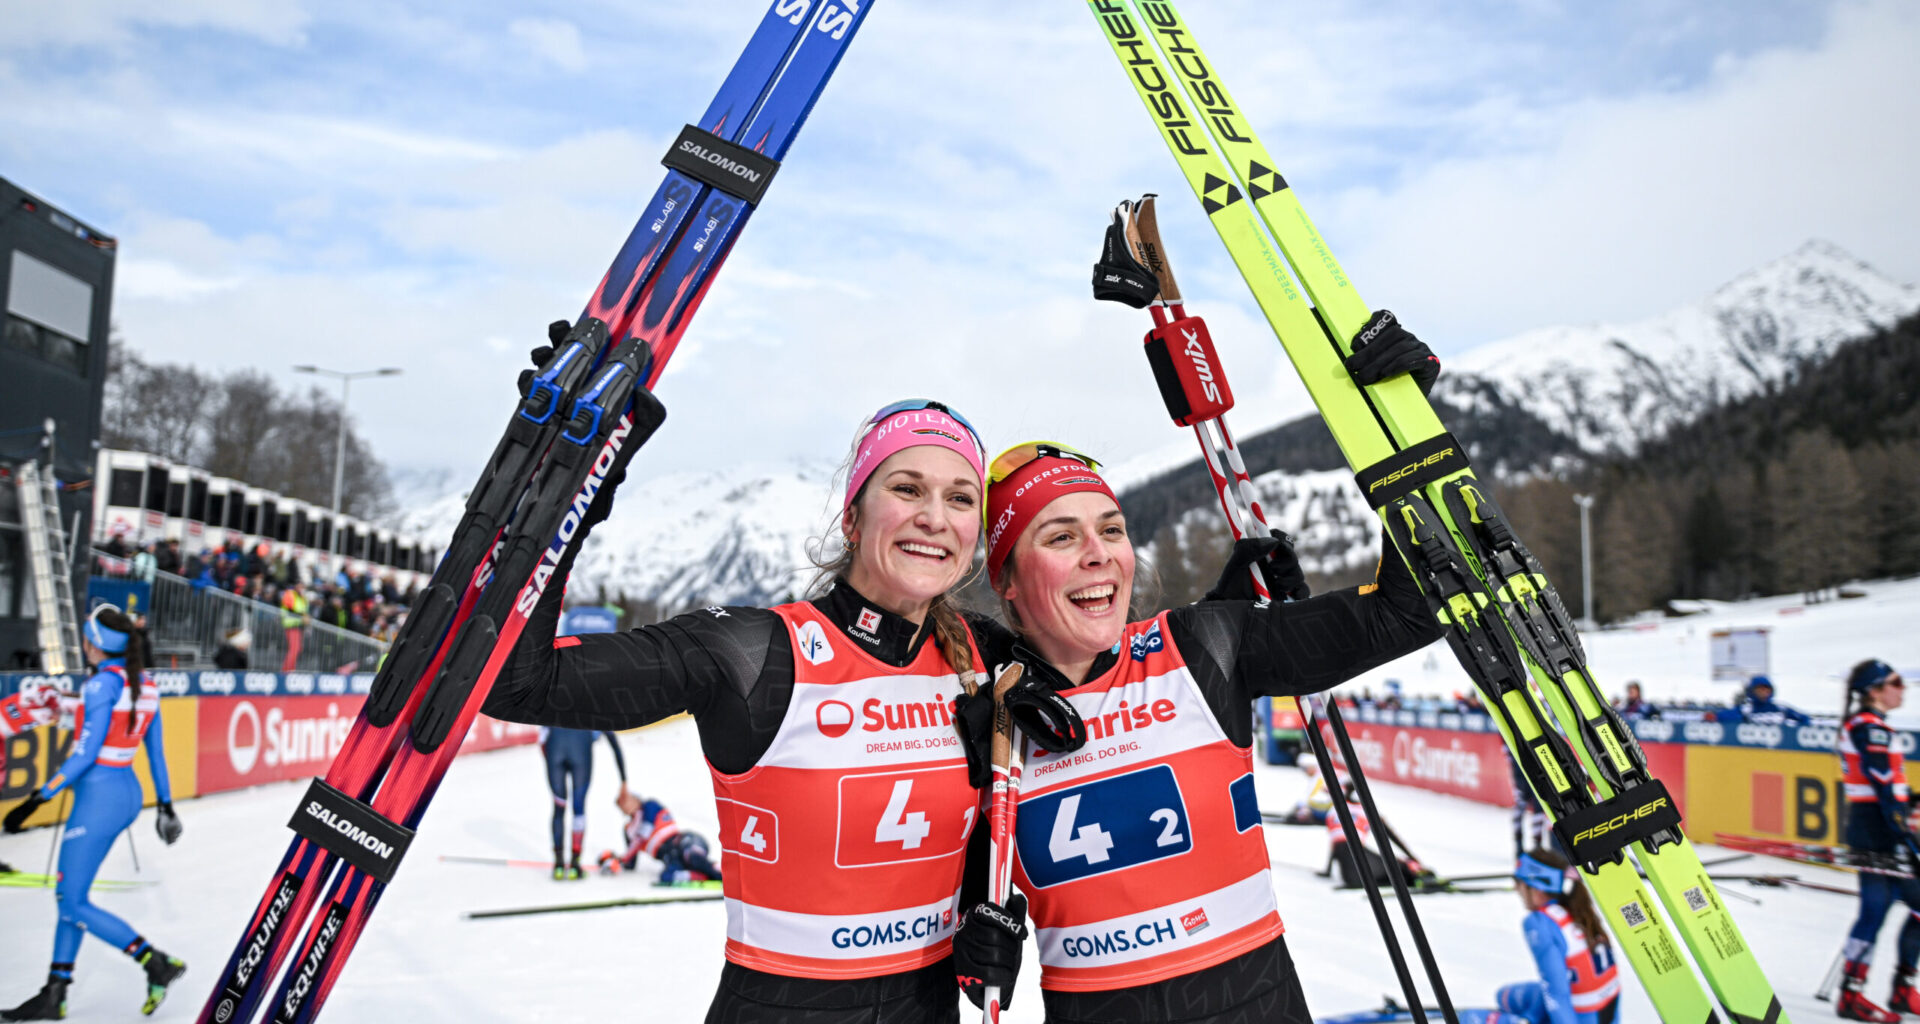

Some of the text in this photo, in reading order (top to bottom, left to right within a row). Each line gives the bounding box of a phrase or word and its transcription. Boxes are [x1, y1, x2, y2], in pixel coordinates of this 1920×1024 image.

[1142, 0, 1253, 144] FISCHE
[679, 140, 761, 183] SALOMON
[1369, 447, 1454, 493] FISCHER
[517, 414, 635, 619] SALOMON
[847, 625, 881, 646] Kaufland
[199, 672, 236, 697] coop
[862, 694, 958, 732] Sunri
[264, 703, 357, 767] Sunris
[866, 735, 959, 753] DREAM BIG. DO BIG.
[1796, 726, 1838, 748] coo
[1034, 741, 1142, 778] DREAM BIG. DO BIG.
[1412, 737, 1481, 789] Sunrise
[306, 800, 395, 860] SALOMON
[740, 815, 767, 853] 4
[874, 779, 931, 850] 4
[961, 806, 976, 840] 1
[1048, 793, 1114, 865] 4
[1149, 807, 1184, 847] 2
[1573, 797, 1668, 847] FISCHER
[831, 913, 939, 949] GOMS.CH
[1062, 918, 1176, 958] GOMS.CH
